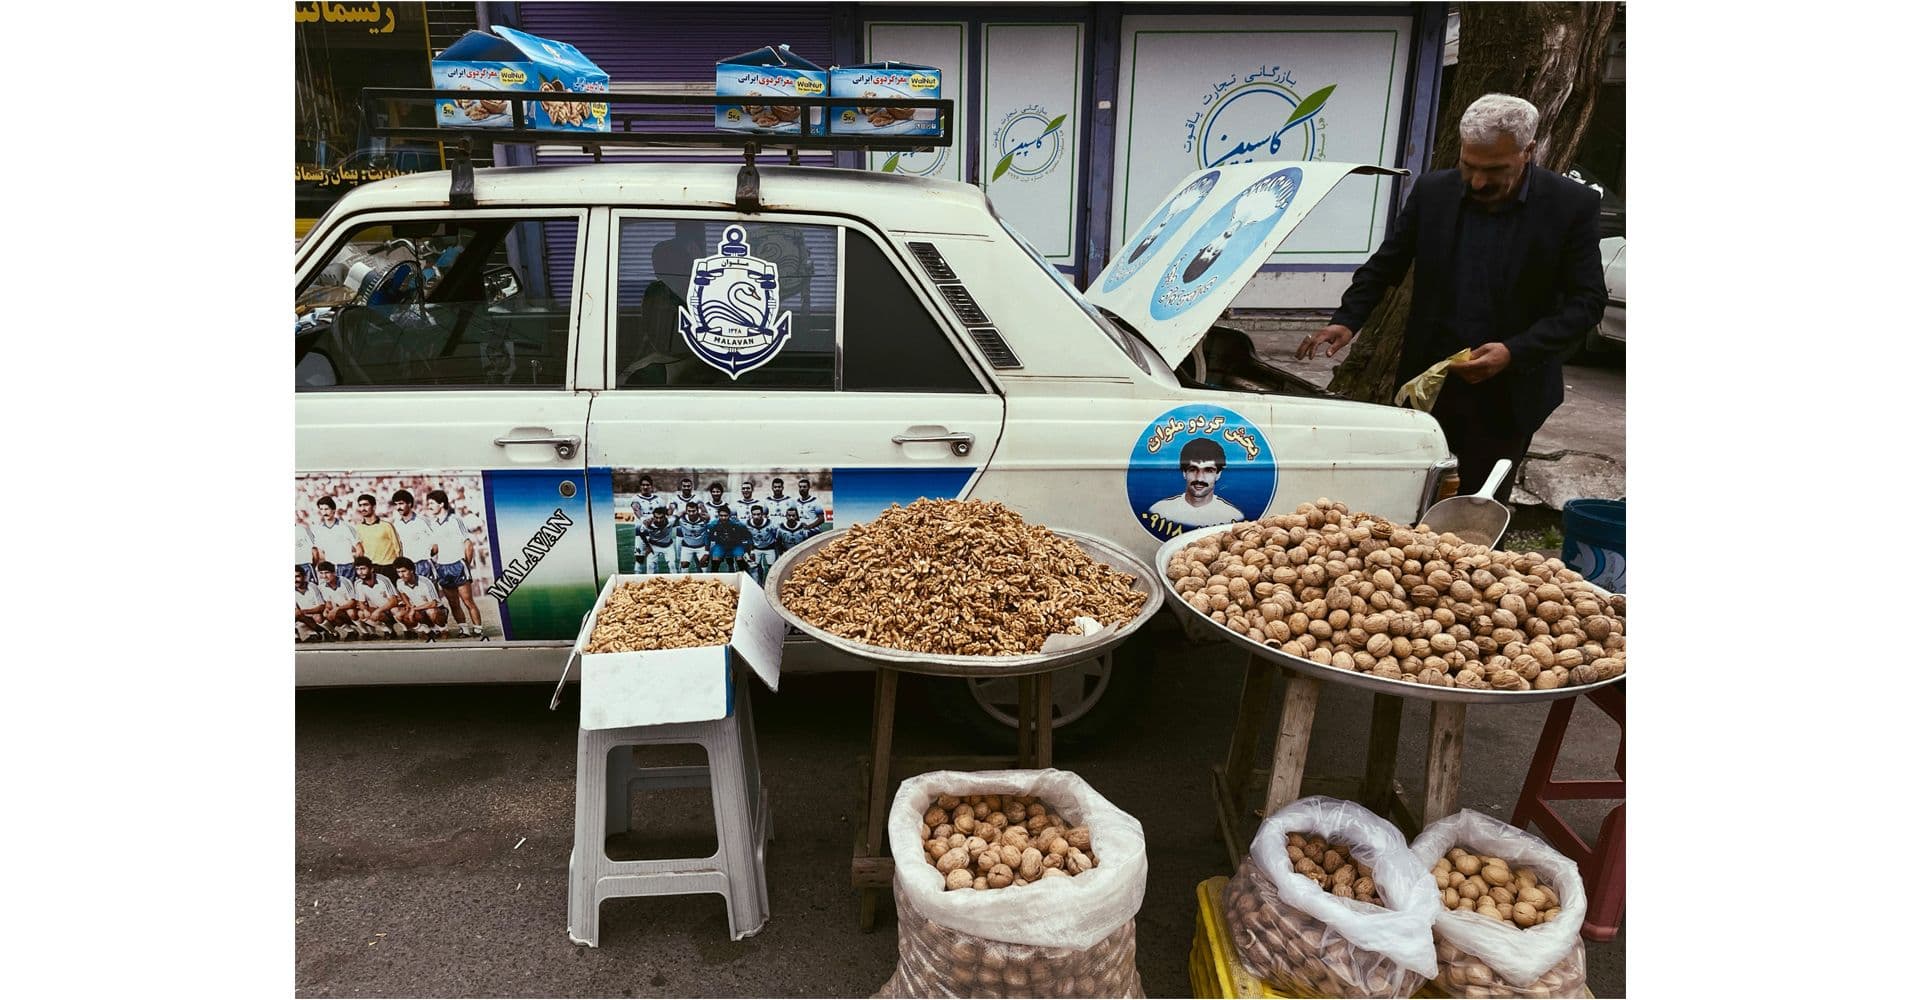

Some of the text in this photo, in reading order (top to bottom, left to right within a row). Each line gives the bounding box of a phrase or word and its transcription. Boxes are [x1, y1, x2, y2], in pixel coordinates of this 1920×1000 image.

[1183, 64, 1297, 154] بازرگانی تجارت یاقوت
[721, 257, 749, 268] ملوان
[713, 336, 754, 345] MALAVAN
[1147, 417, 1185, 453] ملوان
[1188, 415, 1225, 434] گردو
[487, 508, 574, 602] MALAVAN
